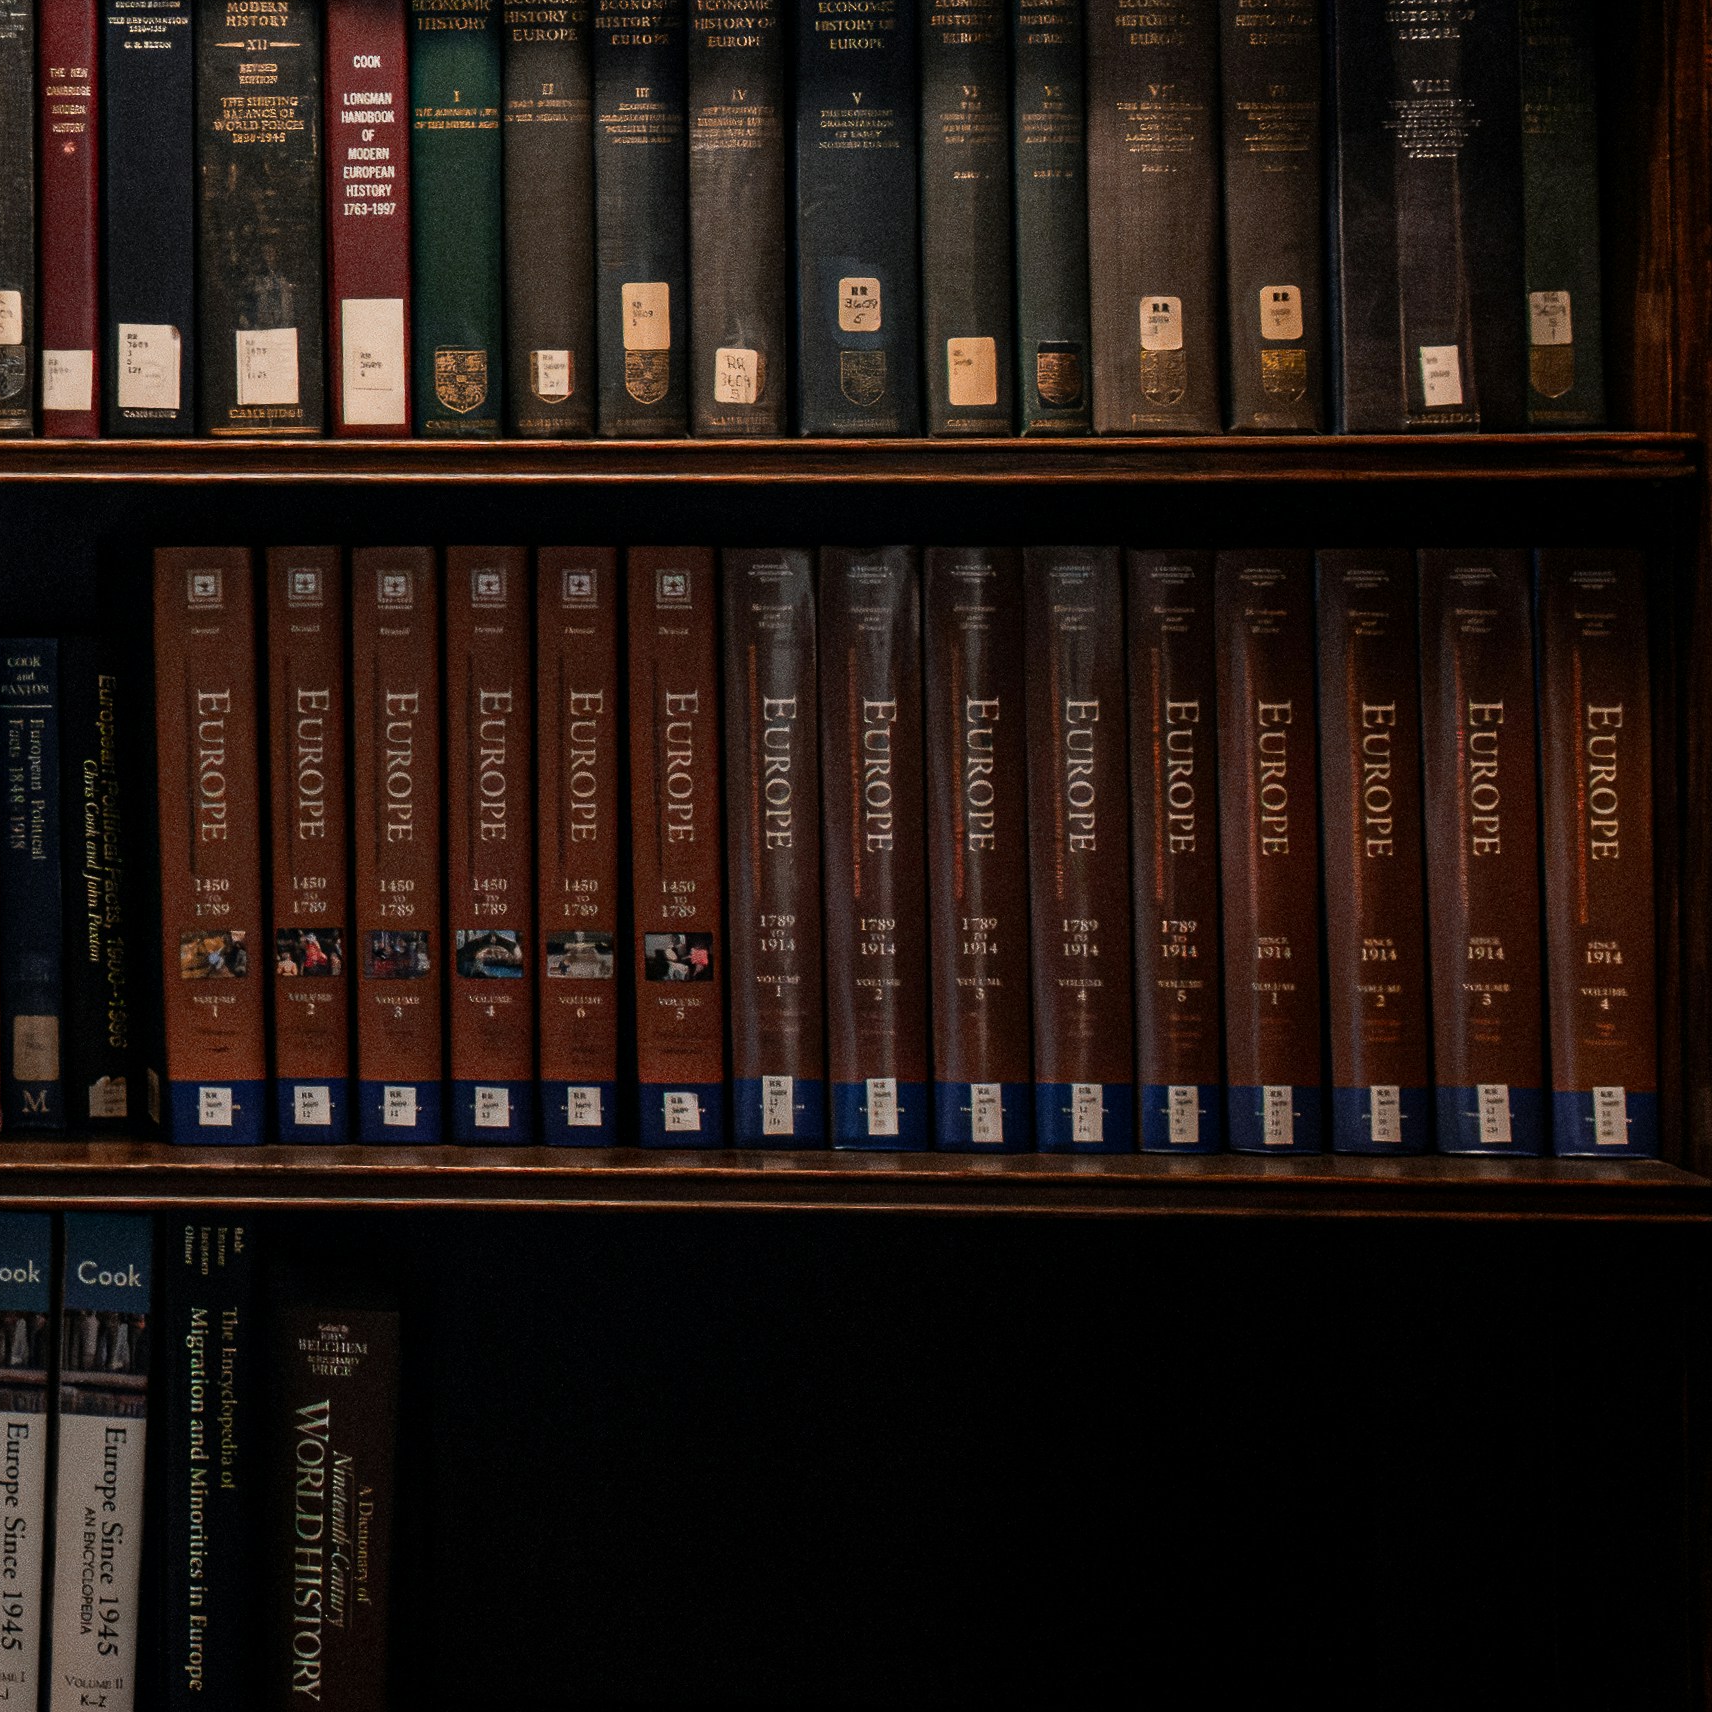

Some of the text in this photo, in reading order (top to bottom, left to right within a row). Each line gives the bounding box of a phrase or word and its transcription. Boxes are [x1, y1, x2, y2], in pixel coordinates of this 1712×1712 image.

[226, 14, 289, 28] HISTORY
[227, 1, 288, 14] MODERN
[353, 55, 381, 68] COOK
[341, 111, 395, 124] HANDBOOK
[343, 92, 392, 106] LONGMAN
[343, 166, 395, 179] EUROPEAN
[348, 147, 390, 161] MODERN
[361, 129, 375, 142] OF
[344, 202, 396, 216] 1763-1997
[346, 184, 391, 197] HISTORY
[197, 687, 231, 843] EUROPE
[296, 687, 330, 841] EUROPE
[385, 687, 419, 843] EUROPE
[479, 687, 513, 843] EUROPE
[569, 687, 604, 844] EUROPE
[665, 688, 700, 845] EUROPE
[762, 695, 797, 852] EUROPE
[863, 696, 898, 853] EUROPE
[965, 695, 1001, 853] EUROPE
[1065, 696, 1101, 854] EUROPE
[1165, 699, 1201, 855] EUROPE
[1257, 699, 1293, 857] EUROPE
[1360, 700, 1396, 858] EUROPE
[1467, 699, 1505, 857] EUROPE
[1586, 702, 1624, 862] EUROPE
[78, 1260, 142, 1288] Cook
[0, 1420, 30, 1652] Europe Since 1945
[95, 1426, 127, 1658] Europe Since 1945
[183, 1306, 208, 1693] Migration and Minorities in Europe
[290, 1398, 331, 1702] WORLD HISTORY
